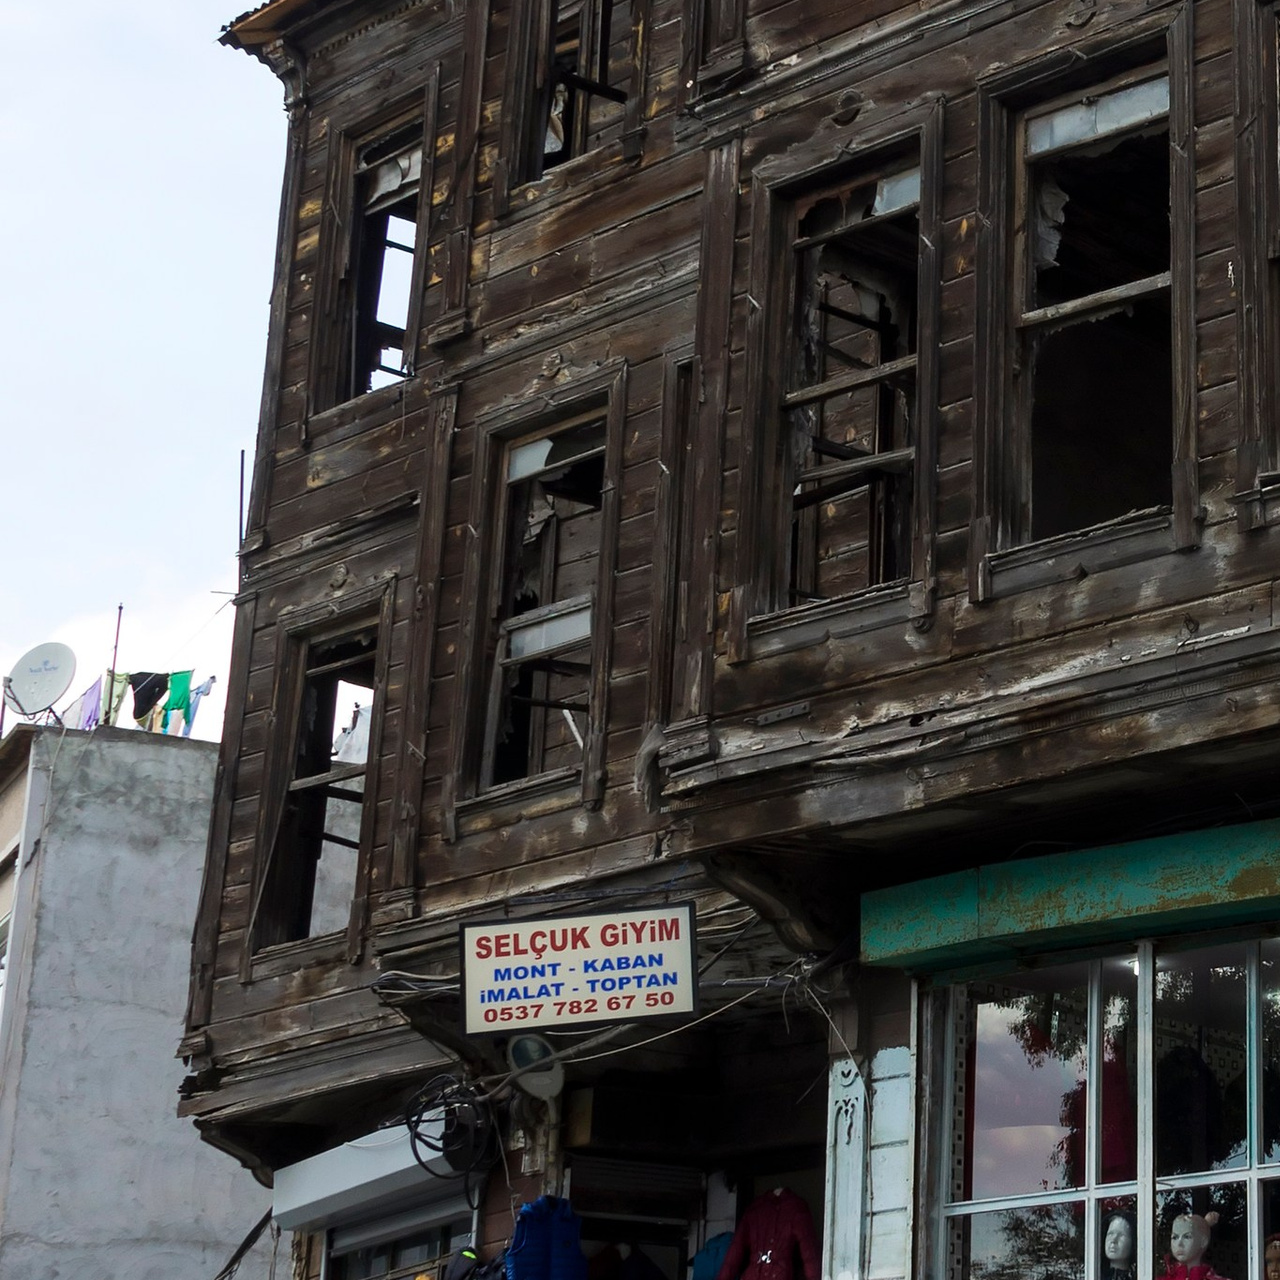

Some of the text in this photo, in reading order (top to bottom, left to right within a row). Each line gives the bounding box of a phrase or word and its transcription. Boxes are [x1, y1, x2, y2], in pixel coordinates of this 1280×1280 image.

[475, 926, 591, 960] SELÇUK
[494, 963, 561, 982] MONT
[583, 953, 664, 974] KABAN
[586, 972, 678, 994] TOPTAN
[484, 991, 675, 1022] 0537 782 67 50
